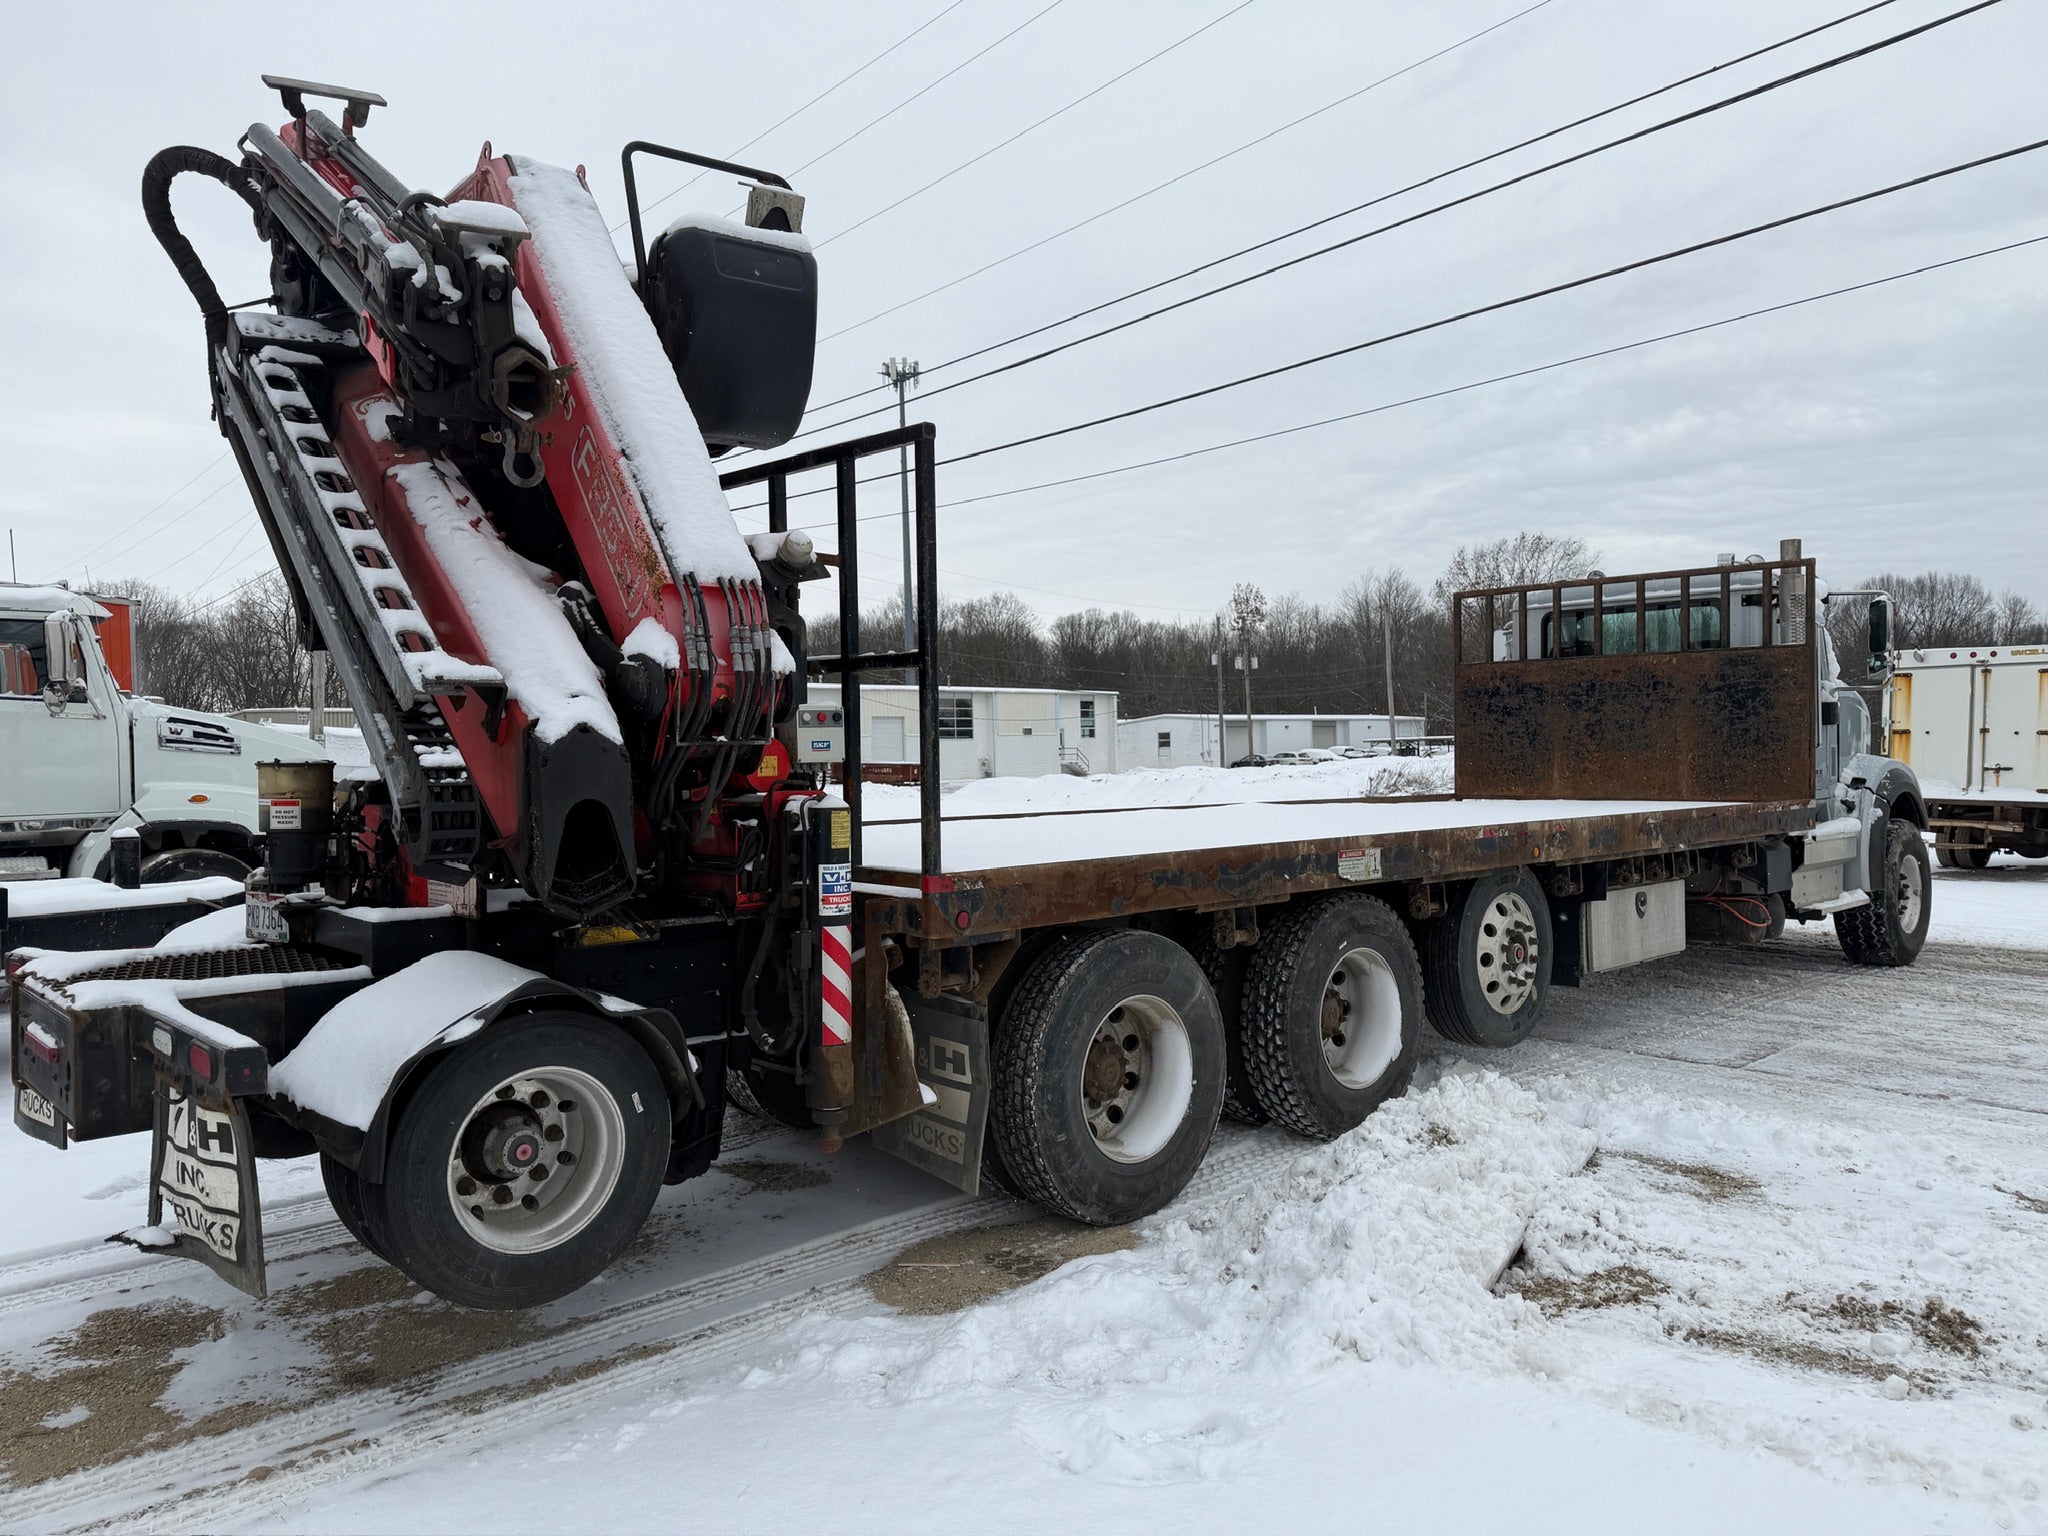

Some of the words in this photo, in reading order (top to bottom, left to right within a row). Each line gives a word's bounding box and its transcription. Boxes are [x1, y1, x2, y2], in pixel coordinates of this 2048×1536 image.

[812, 741, 830, 749] SKF
[1346, 850, 1362, 858] DANGER
[834, 884, 850, 893] INC.
[261, 905, 283, 931] 7364
[918, 1047, 928, 1067] &
[933, 1044, 967, 1076] H
[189, 1120, 197, 1147] &
[197, 1117, 234, 1155] H
[176, 1160, 210, 1197] INC.
